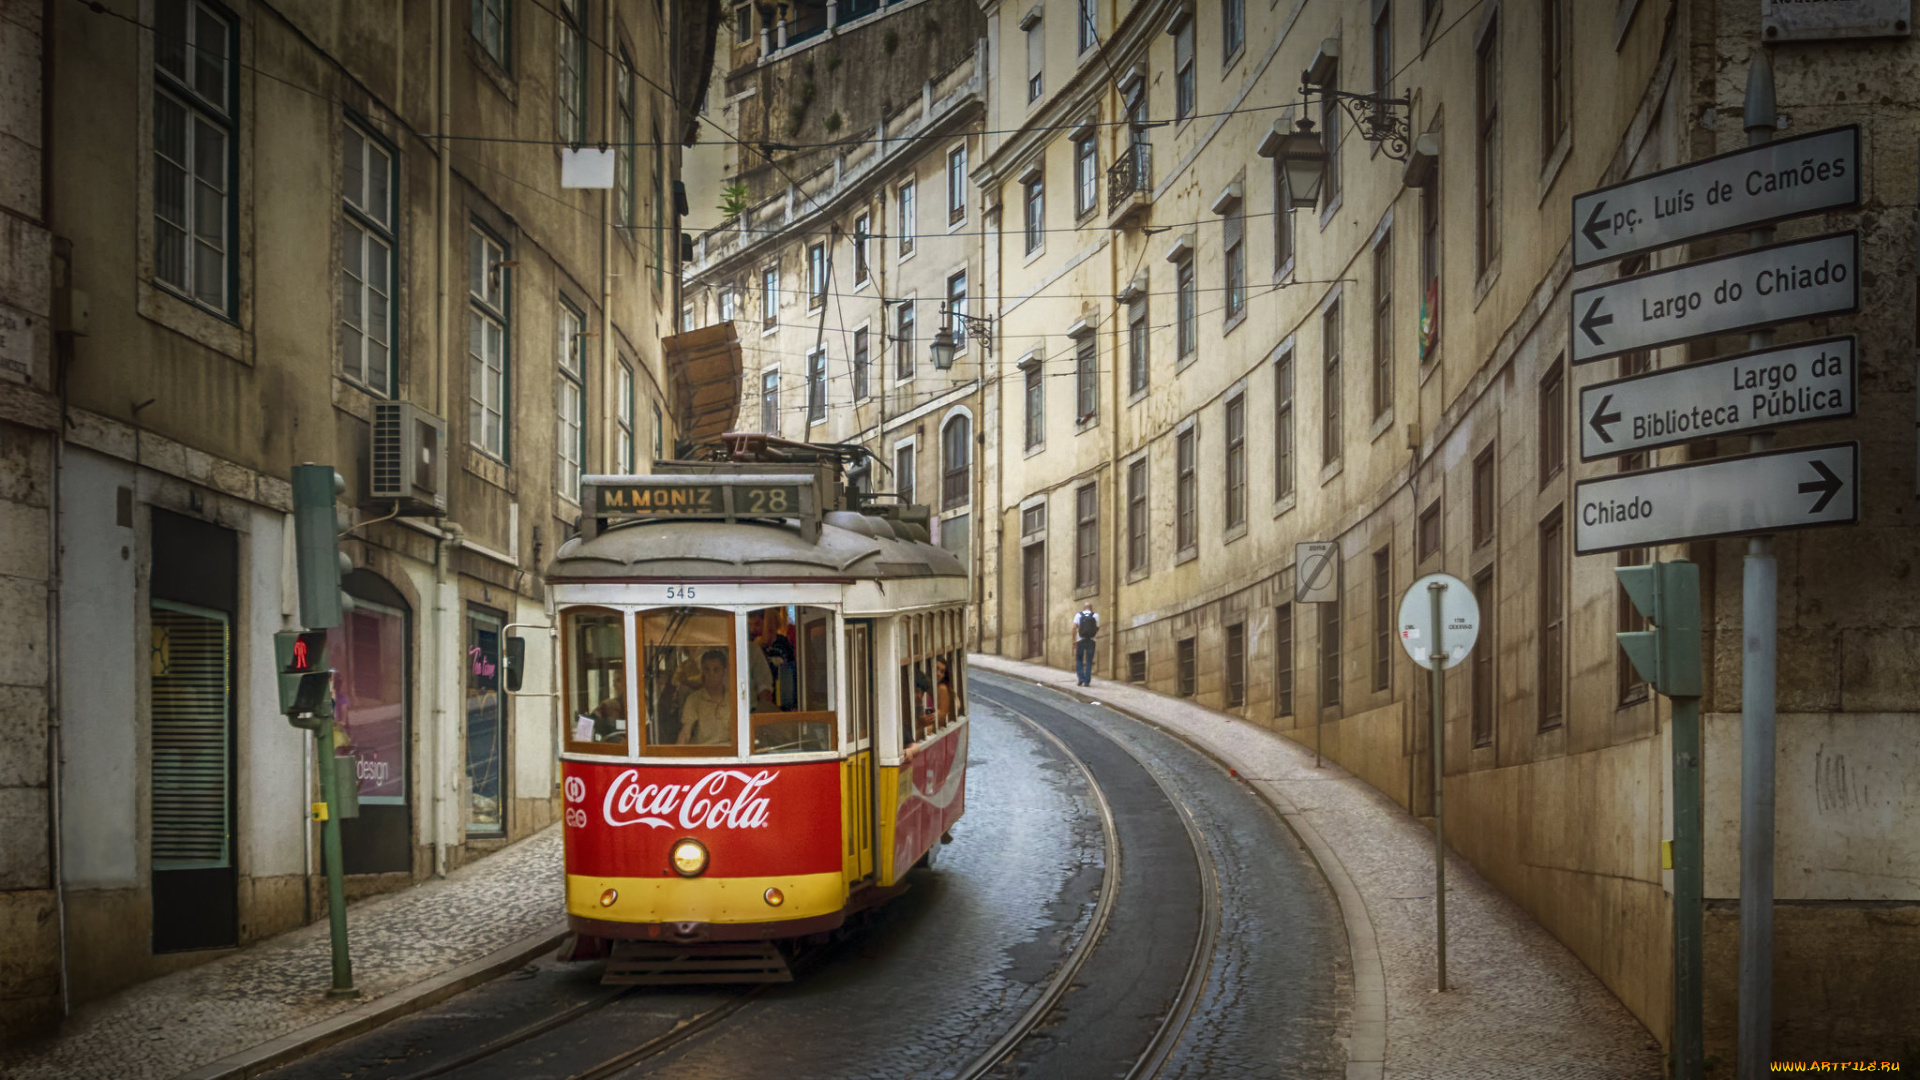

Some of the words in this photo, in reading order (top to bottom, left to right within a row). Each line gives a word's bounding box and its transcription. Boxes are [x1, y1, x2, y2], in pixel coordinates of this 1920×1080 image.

[1613, 208, 1643, 234] pç.
[1653, 189, 1694, 220] Luís
[1706, 181, 1733, 206] de
[1745, 157, 1846, 197] Camões
[1642, 291, 1701, 322] Largo
[1714, 279, 1743, 305] do
[1756, 259, 1847, 296] Chiado
[1733, 362, 1797, 391] Largo
[1811, 352, 1843, 379] da
[1632, 404, 1740, 440] Biblioteca
[1752, 388, 1843, 420] Pública
[748, 489, 788, 514] 28
[1583, 496, 1653, 527] Chiado
[666, 586, 696, 599] 545
[355, 752, 389, 787] design
[602, 769, 780, 830] Coca-Cola
